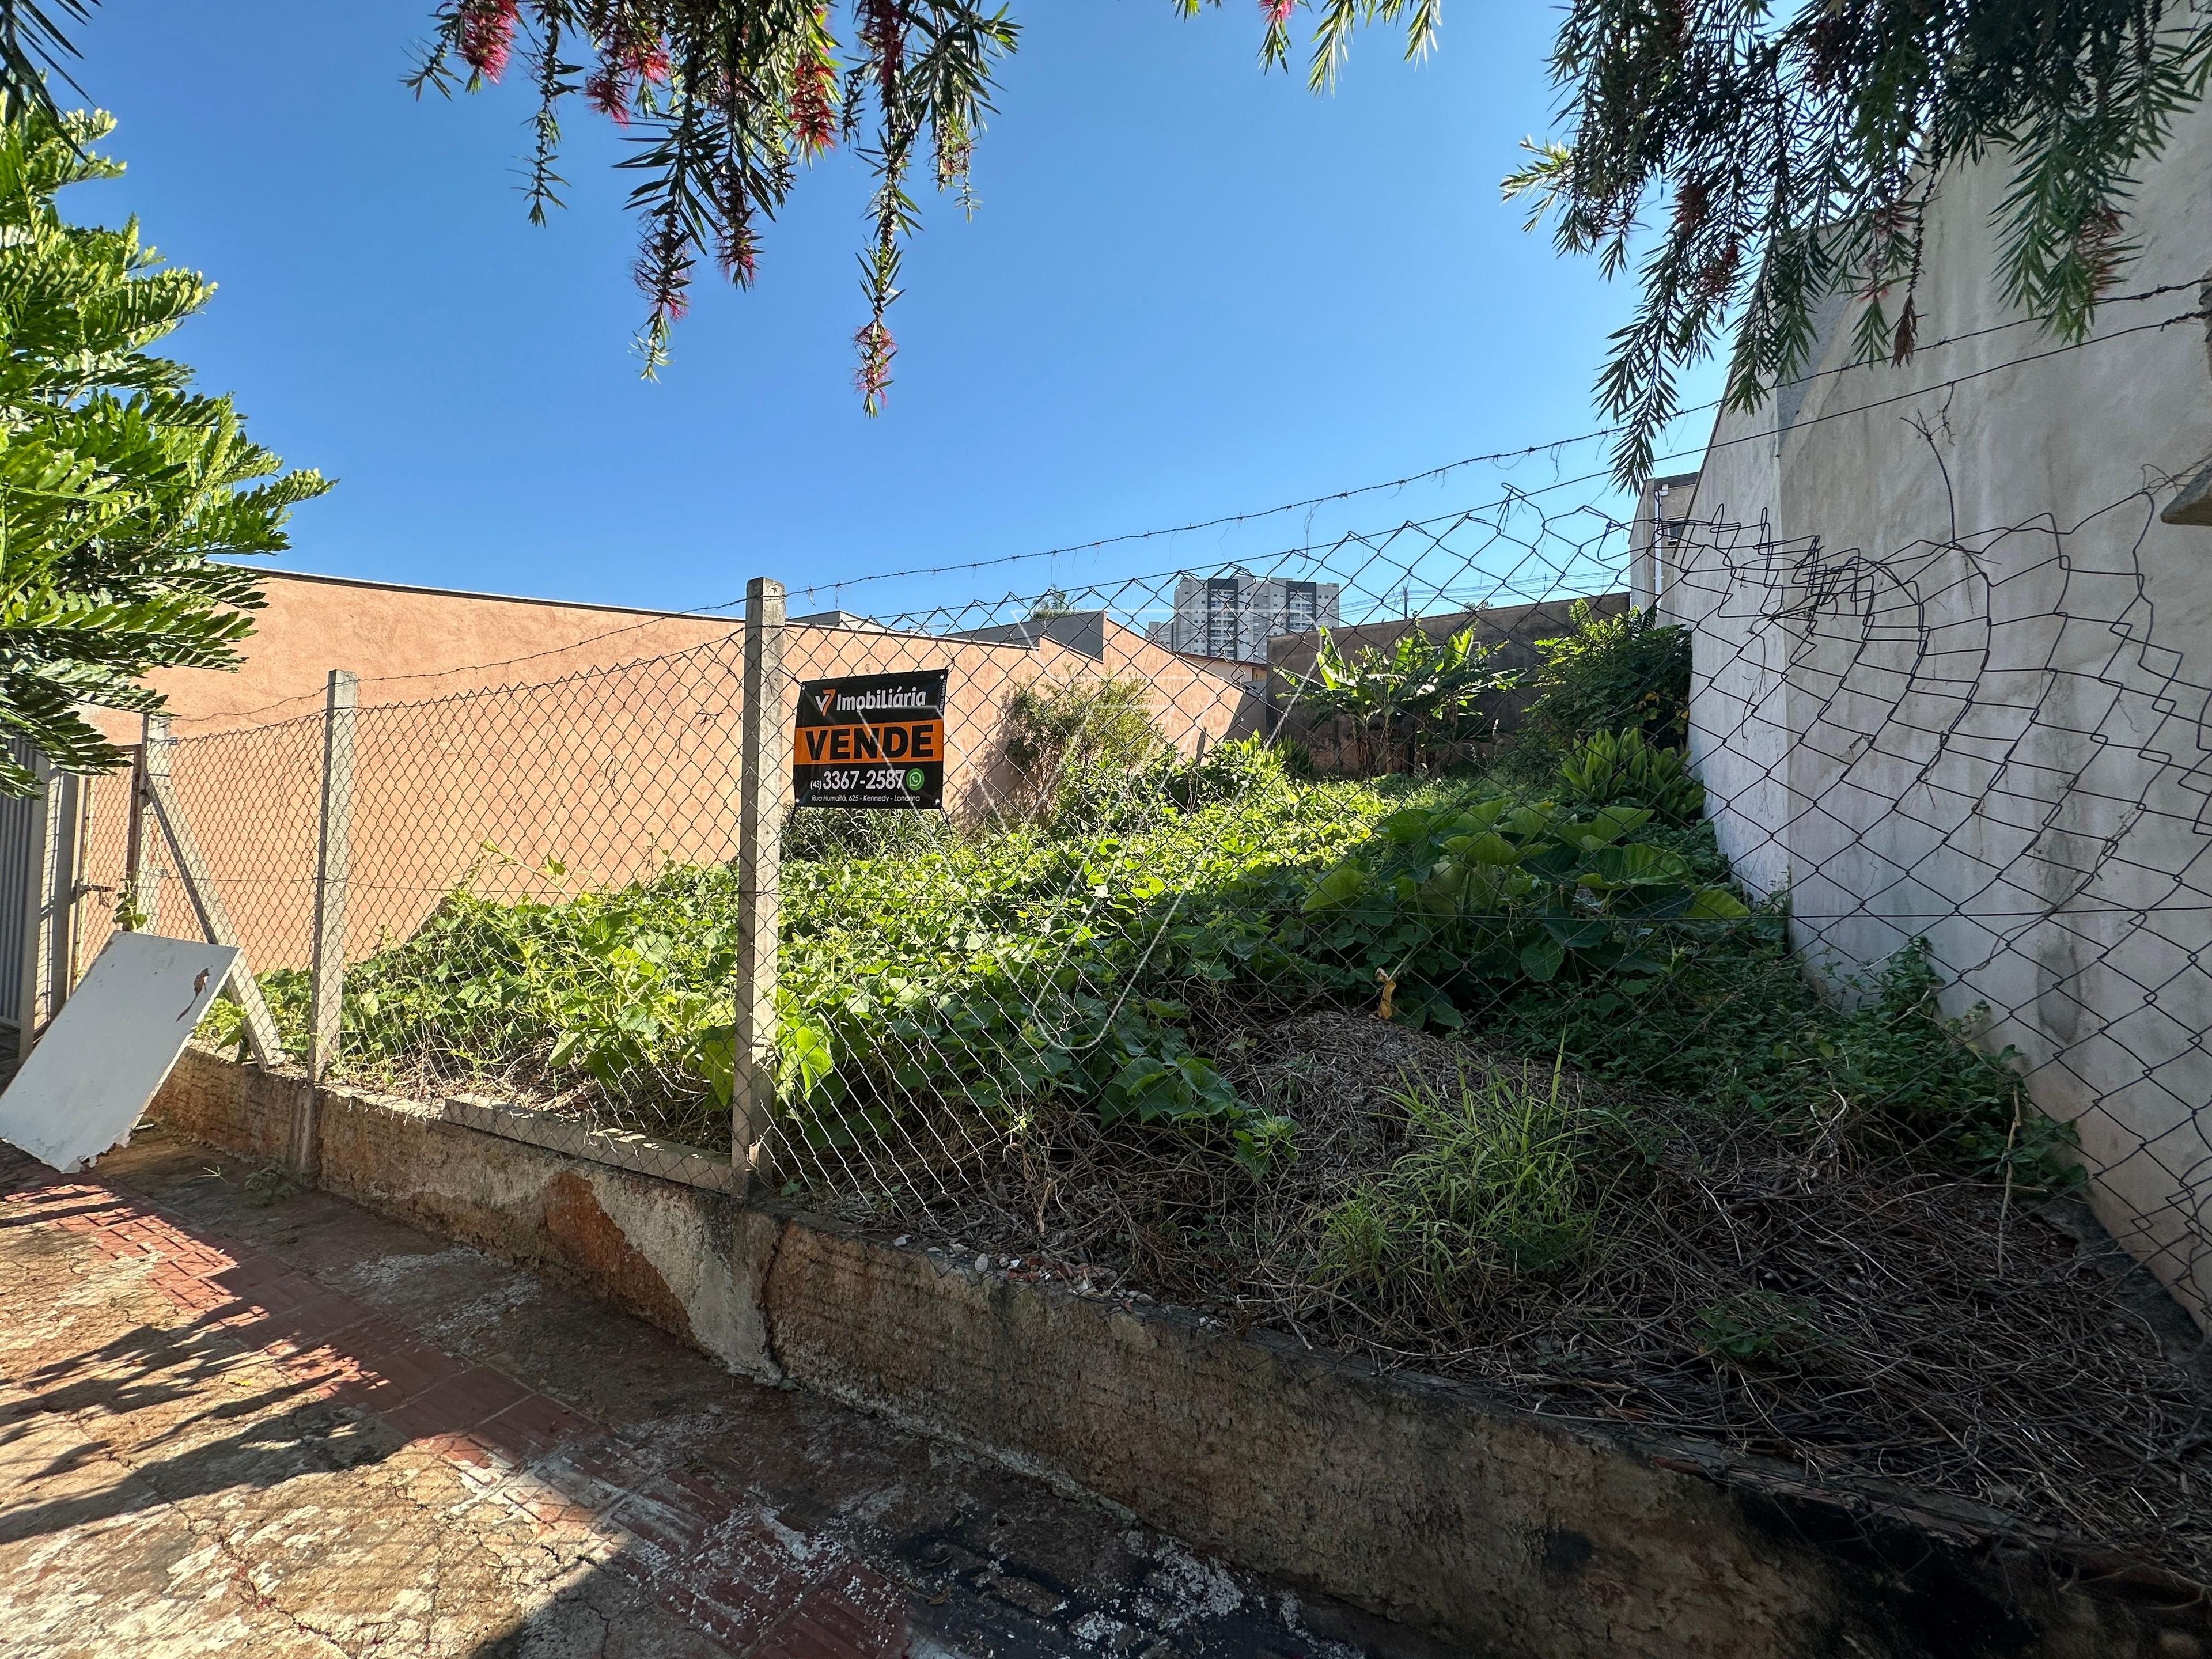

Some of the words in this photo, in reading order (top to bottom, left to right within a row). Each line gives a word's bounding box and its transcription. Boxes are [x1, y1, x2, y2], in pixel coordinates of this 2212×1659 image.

[836, 686, 926, 711] Imobiliária
[805, 724, 933, 760] VENDE
[810, 780, 822, 790] (43)
[823, 770, 906, 790] 3367-2587
[863, 794, 889, 803] Kennedy
